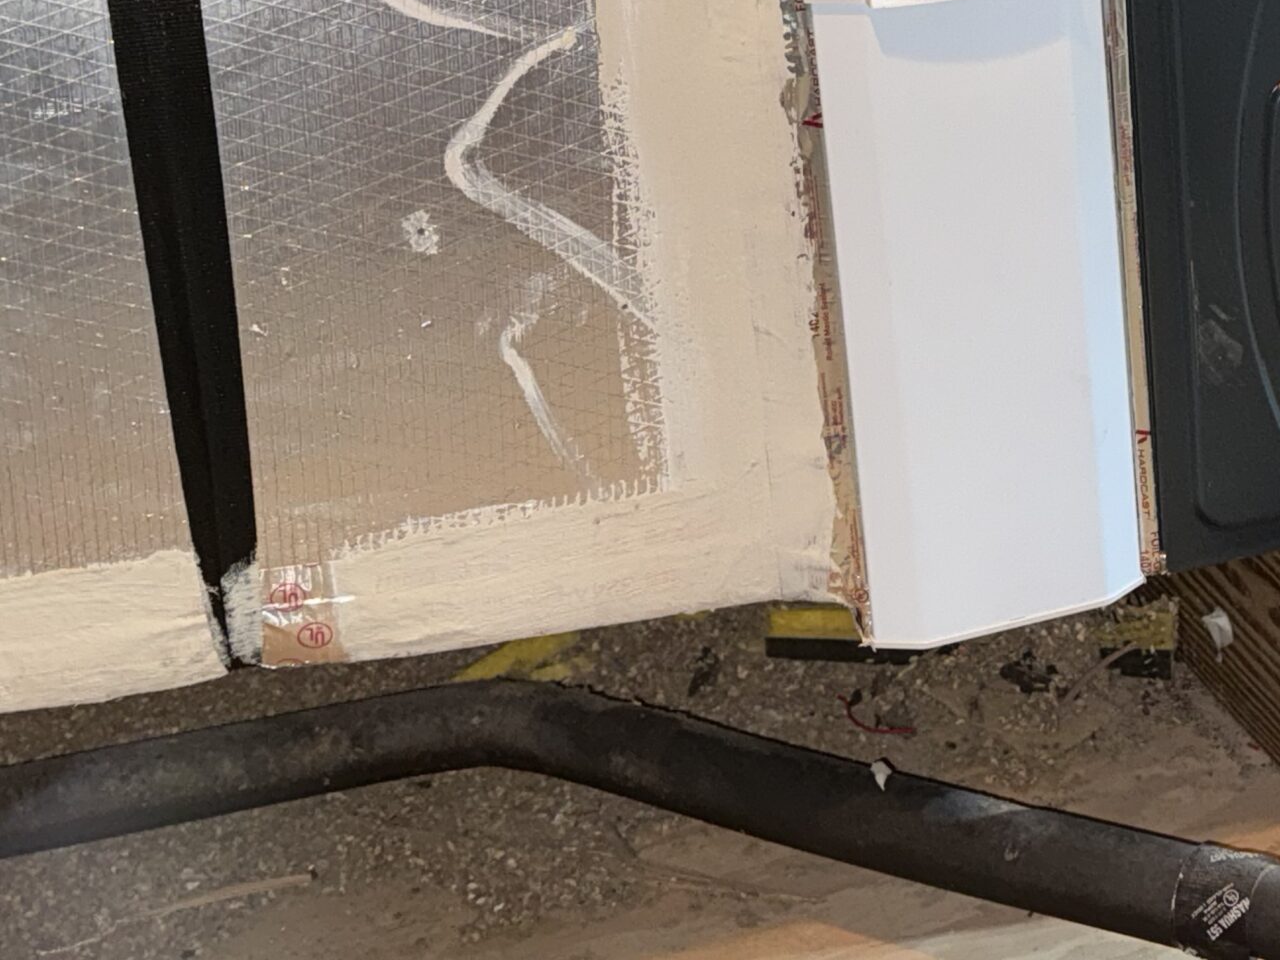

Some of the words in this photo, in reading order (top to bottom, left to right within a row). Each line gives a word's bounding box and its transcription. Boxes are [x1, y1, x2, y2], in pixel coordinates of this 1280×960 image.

[1137, 448, 1151, 519] HARDCAST
[1218, 897, 1251, 930] NASHUA
[1206, 923, 1223, 941] 557
